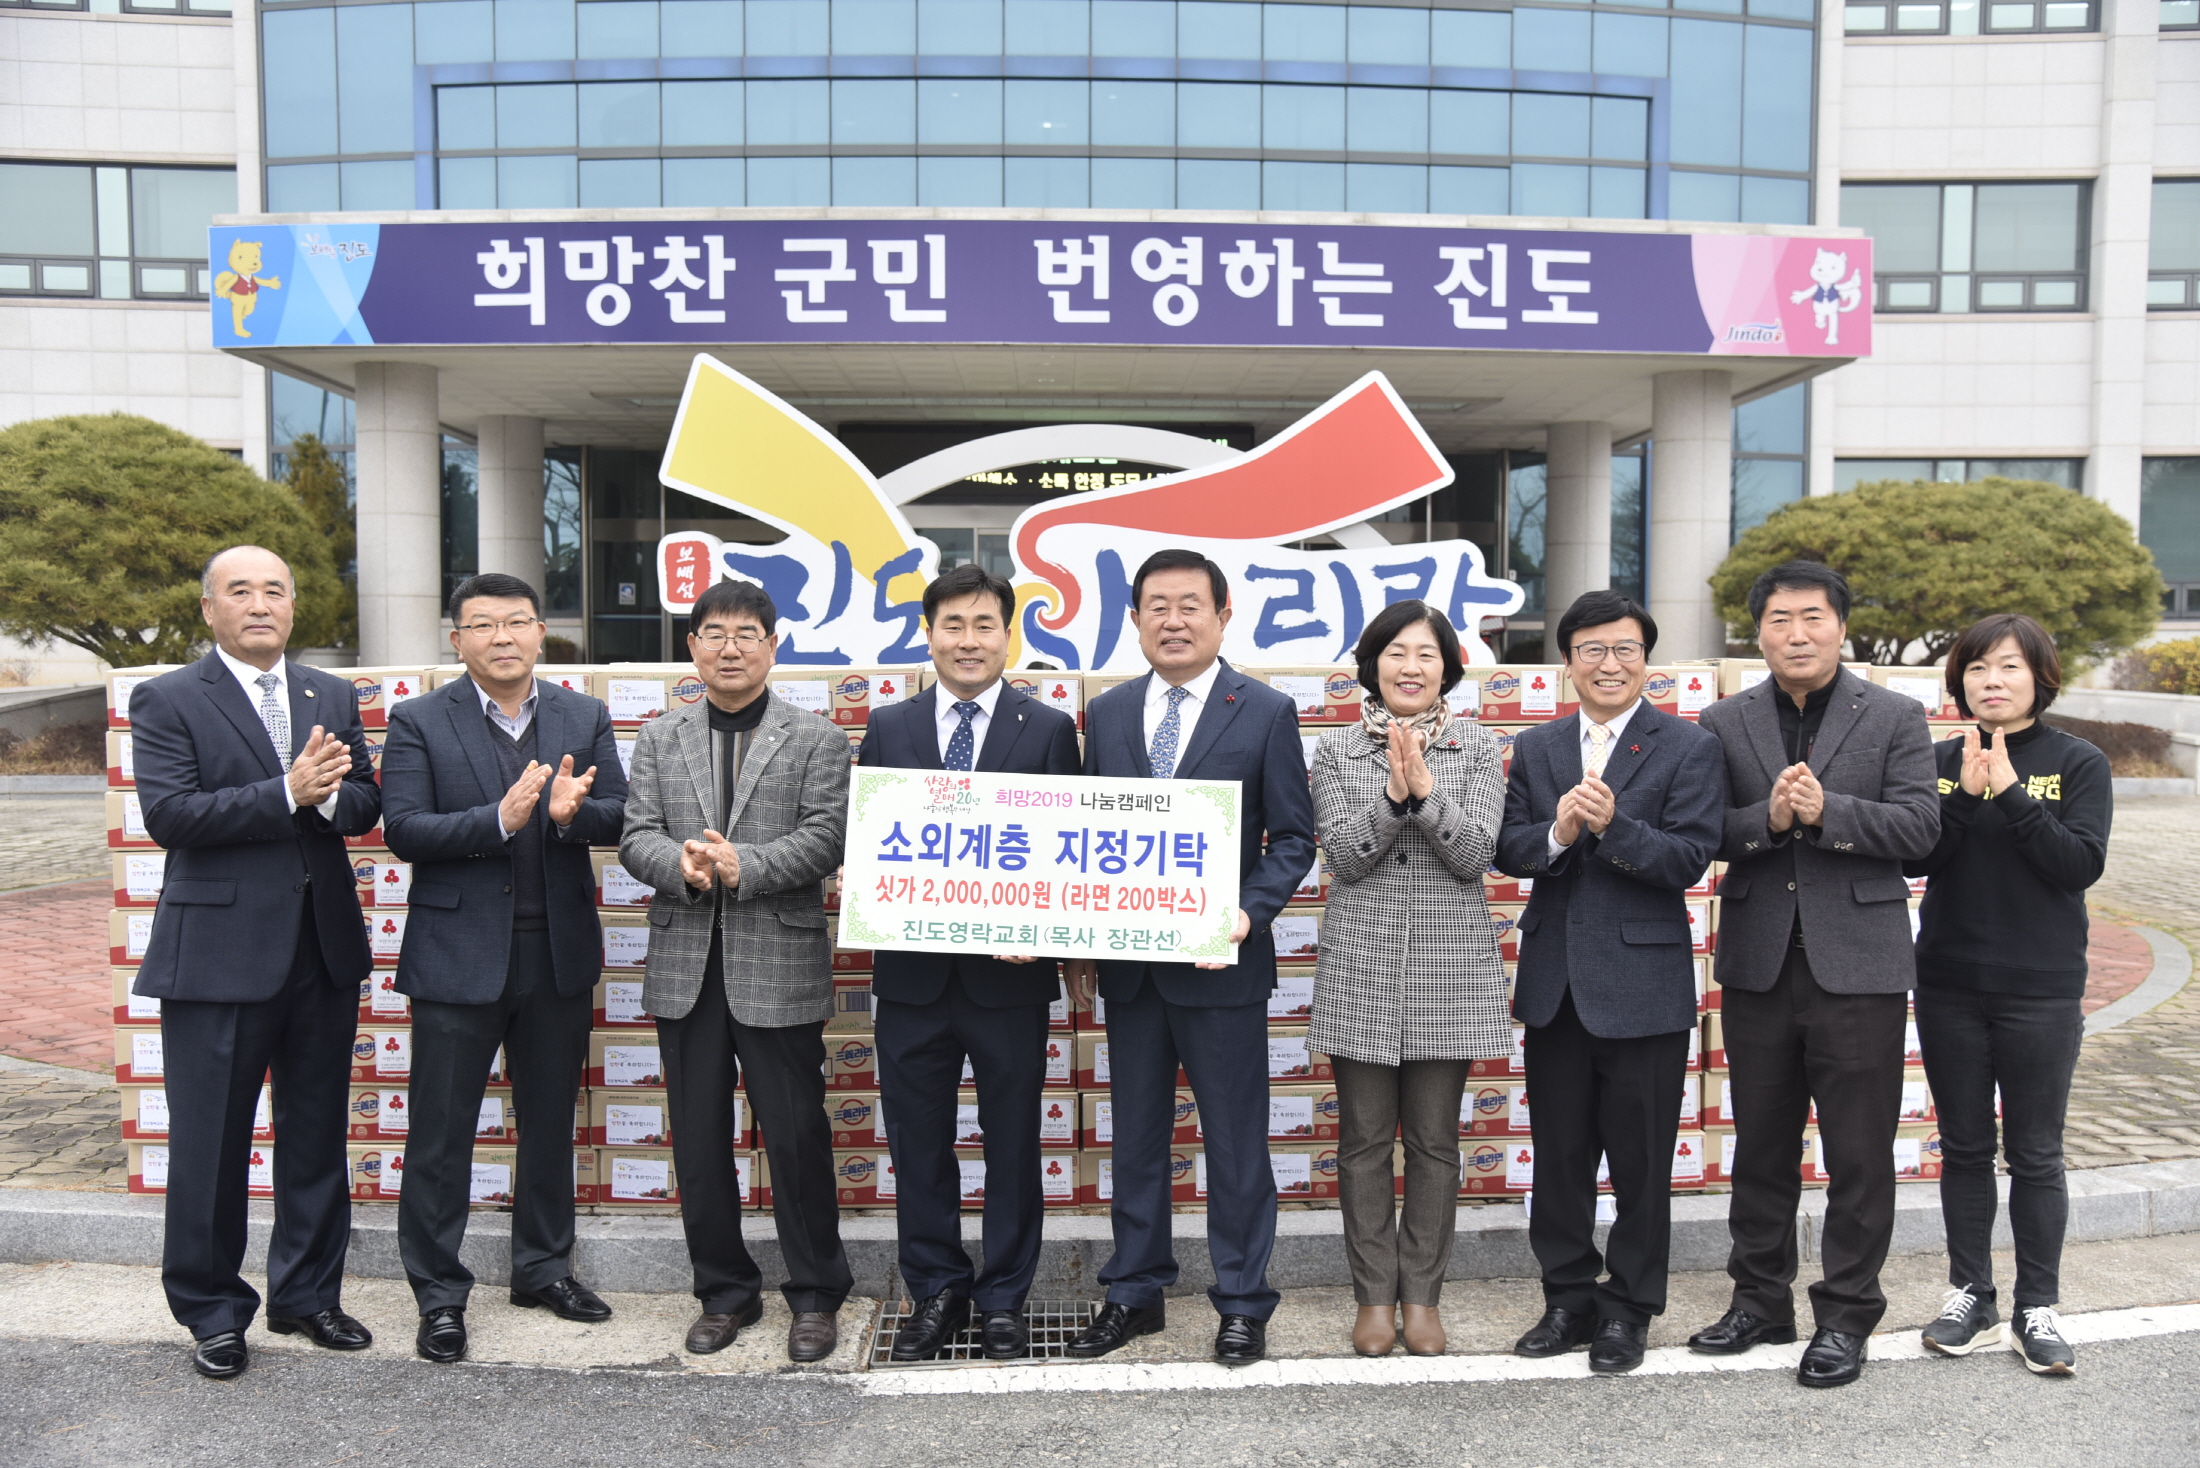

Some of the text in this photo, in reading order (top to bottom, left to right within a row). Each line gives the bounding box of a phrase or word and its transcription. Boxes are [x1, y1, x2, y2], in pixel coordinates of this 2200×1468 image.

[339, 241, 374, 262] 진도
[475, 234, 1599, 330] 희망찬 군민 번영하는 진도
[1723, 326, 1773, 342] Jindo
[1074, 472, 1105, 492] 안정
[676, 546, 695, 599] 보배섬
[924, 775, 957, 792] 사랑의
[930, 787, 981, 806] 열매 20년
[995, 788, 1172, 813] 희망2019 나눔캠페인
[876, 821, 1208, 877] 소외계층 지정기탁
[875, 874, 1207, 916] 싯가 2,000,000원 (라면 200박스)
[1106, 928, 1182, 951] 장관선)
